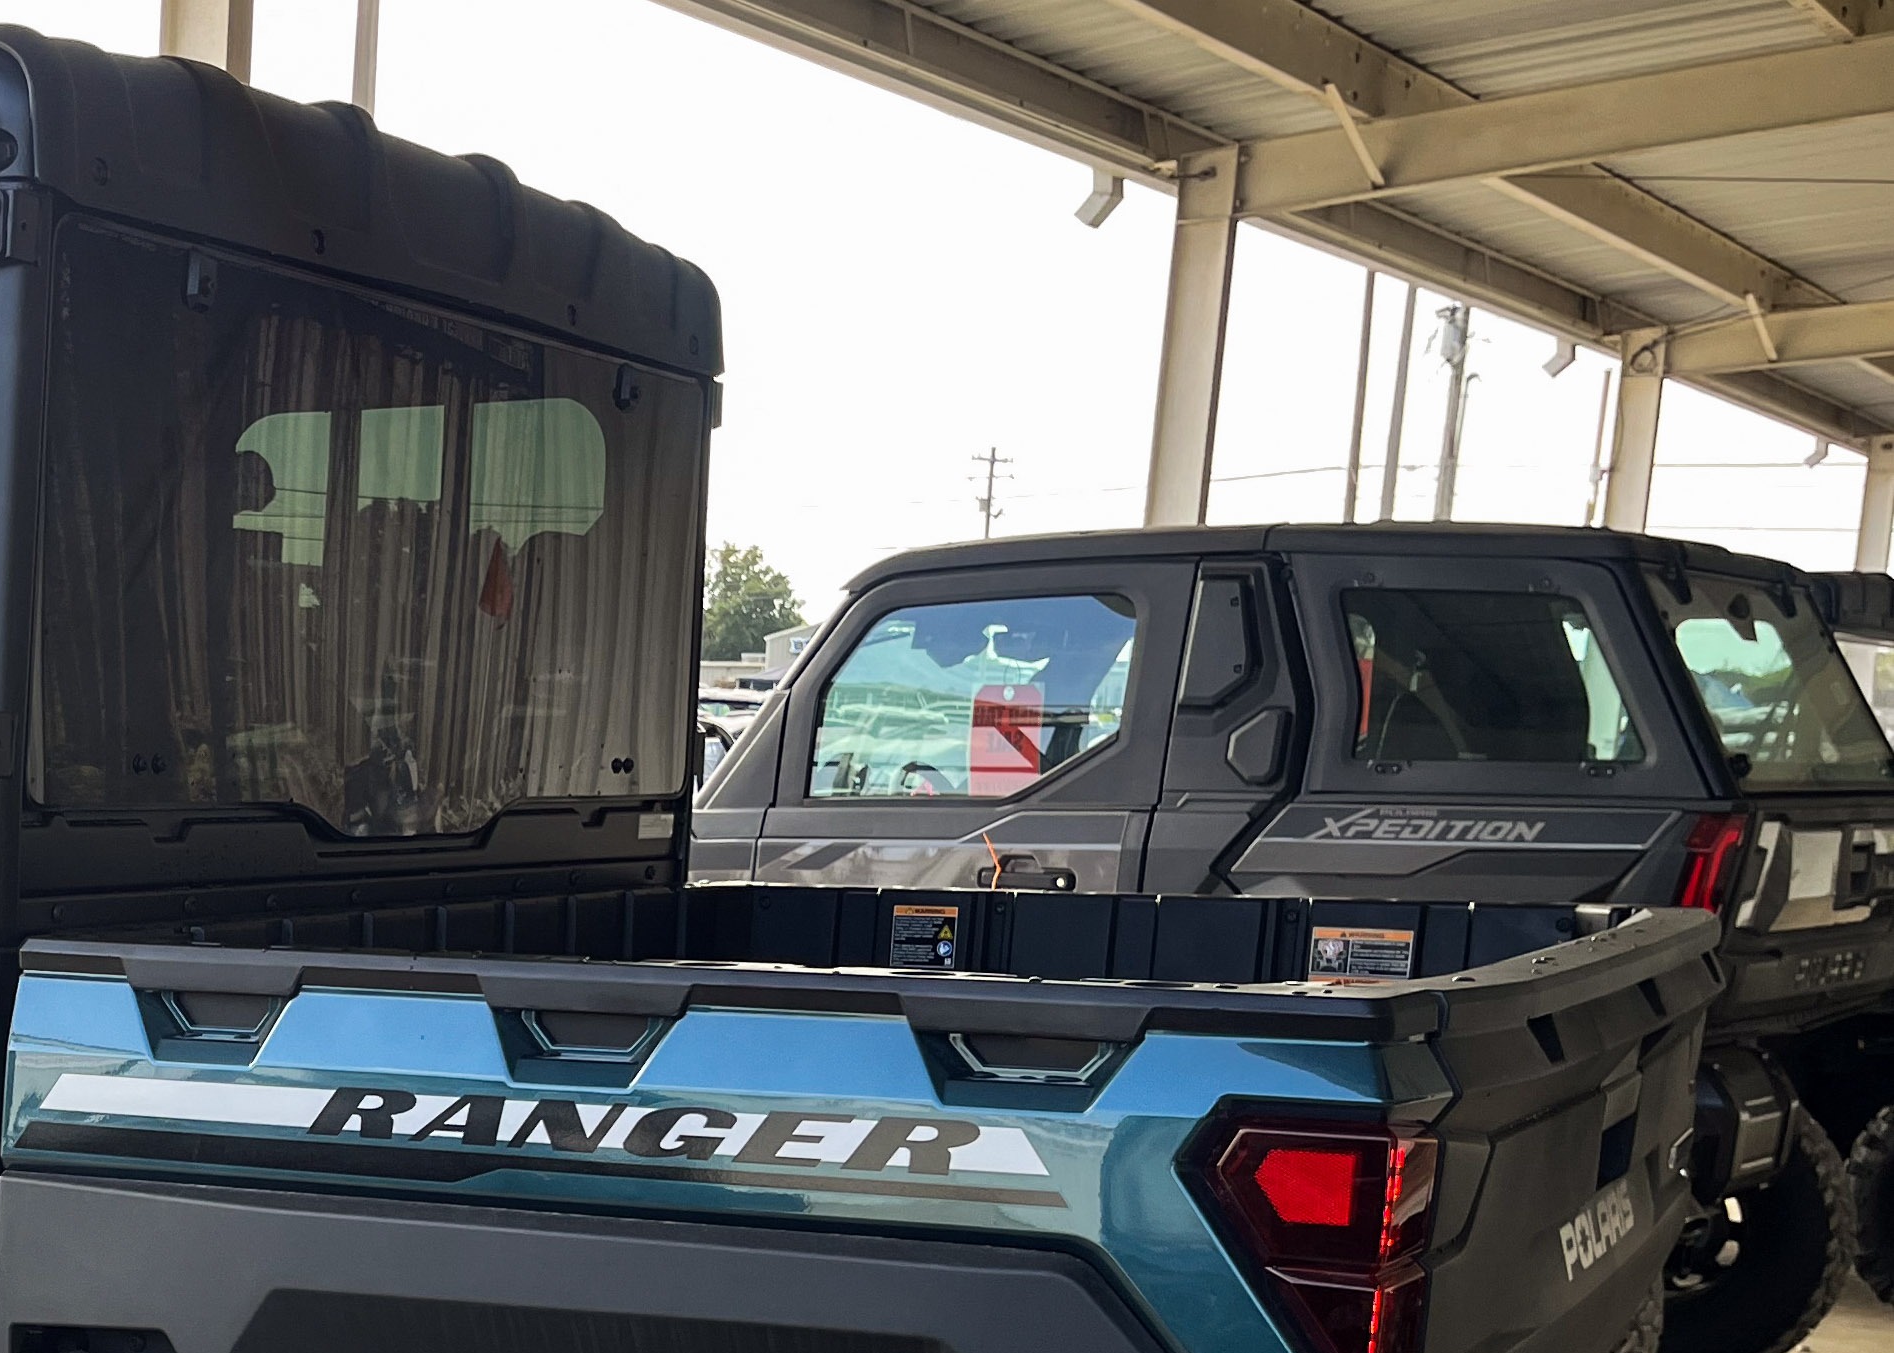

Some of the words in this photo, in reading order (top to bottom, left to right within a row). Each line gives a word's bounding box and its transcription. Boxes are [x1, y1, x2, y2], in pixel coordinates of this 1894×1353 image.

[1307, 807, 1545, 841] XPEDITION
[307, 1087, 981, 1175] RANGER
[1559, 1178, 1634, 1282] POLARIS
